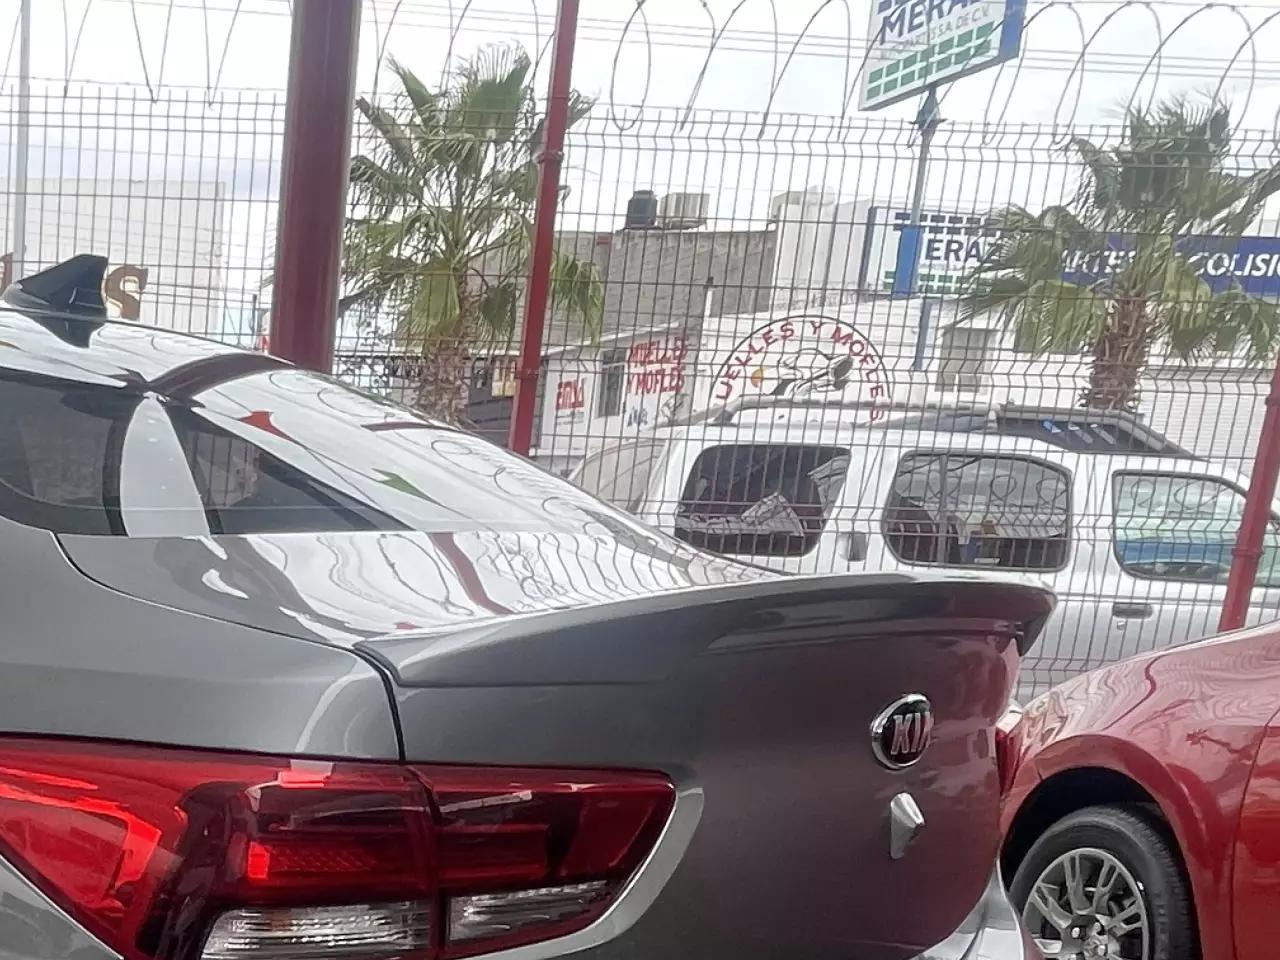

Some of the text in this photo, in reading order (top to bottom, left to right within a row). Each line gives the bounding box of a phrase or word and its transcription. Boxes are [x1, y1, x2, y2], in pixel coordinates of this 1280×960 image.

[880, 0, 982, 46] MER
[716, 321, 796, 401] UELLES
[810, 320, 827, 336] Y
